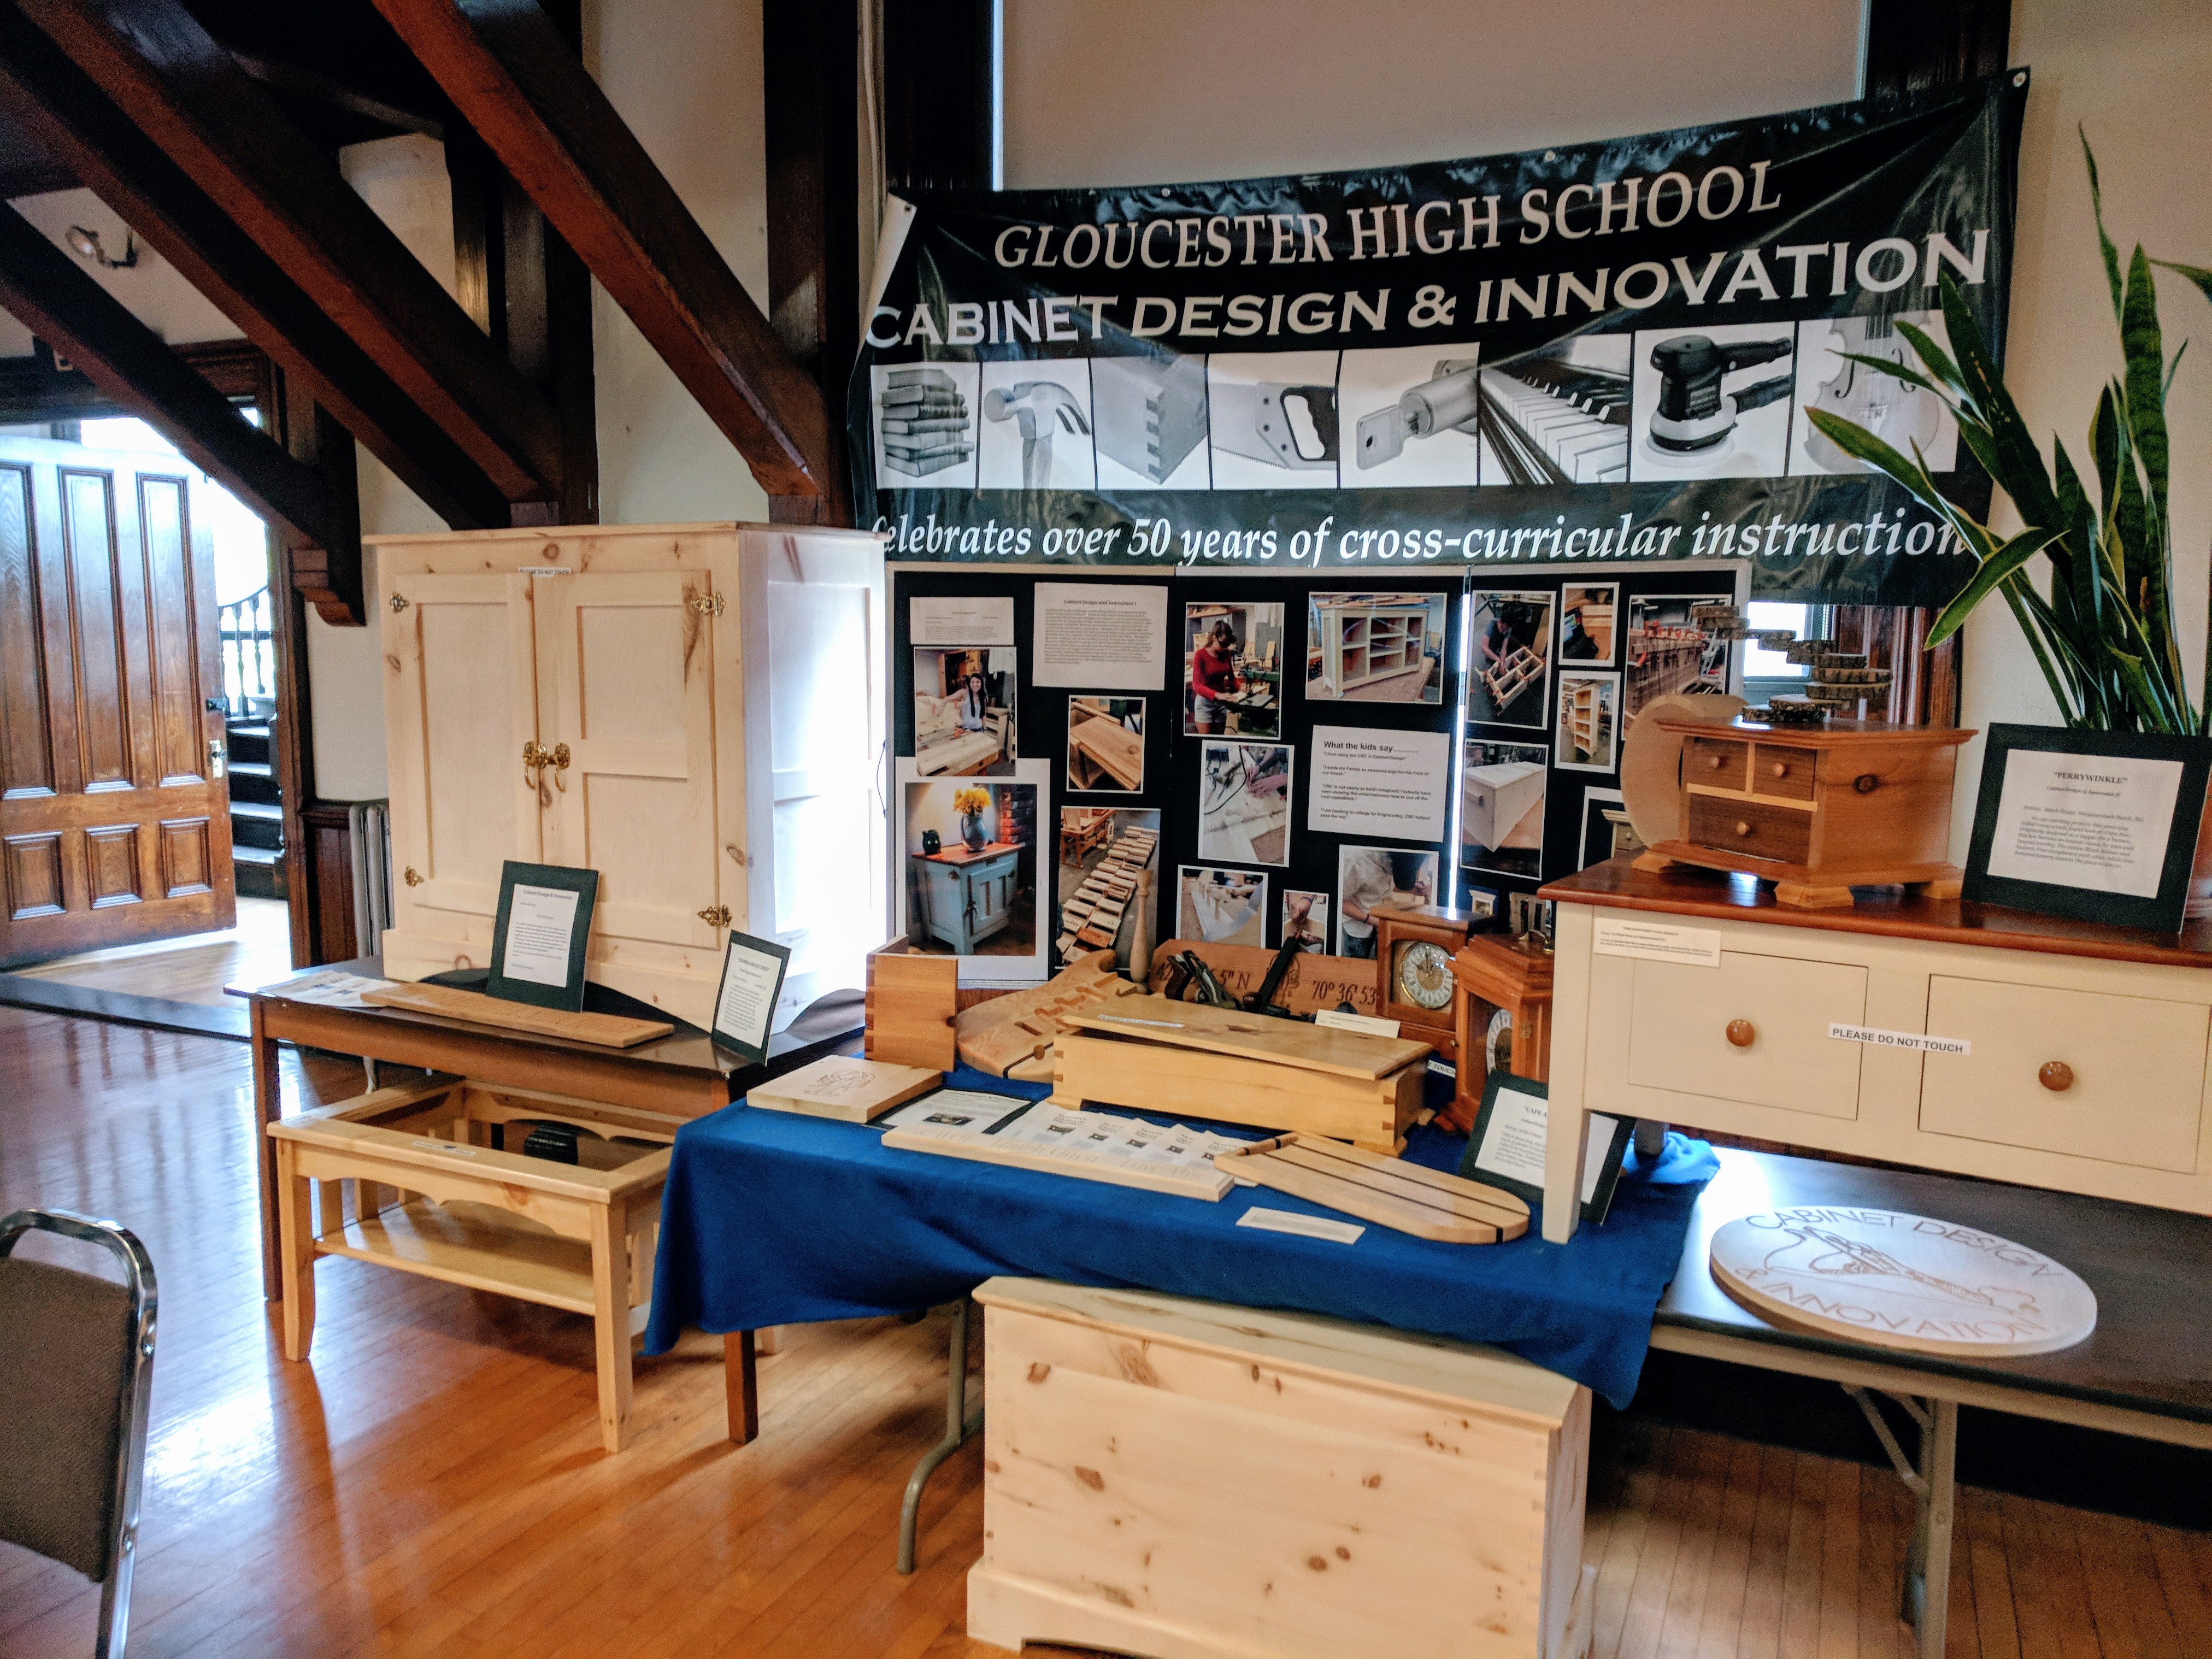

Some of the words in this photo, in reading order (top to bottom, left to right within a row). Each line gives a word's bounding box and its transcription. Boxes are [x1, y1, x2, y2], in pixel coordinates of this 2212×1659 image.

[995, 213, 1334, 269] GLOUCESTER
[1346, 193, 1500, 261] HIGH
[1519, 160, 1781, 245] SCHOOL
[866, 294, 1119, 349] CABINET
[1132, 287, 1392, 337] DESIGN
[1408, 284, 1456, 326] &
[1474, 228, 1991, 325] INNOVATION
[1042, 519, 1120, 556] over
[1128, 518, 1171, 558] 50
[1179, 522, 1289, 568] years
[1291, 516, 1333, 568] of
[1340, 511, 1681, 561] cross-curricular
[1692, 507, 1967, 558] instruction
[1833, 1028, 1875, 1042] PLEASE
[1878, 1034, 1893, 1044] DO
[1897, 1038, 1919, 1048] NOT
[1923, 1041, 1963, 1054] TOUCH
[1745, 1209, 1905, 1230] CABINET
[1913, 1220, 2064, 1278] DESIGN
[1762, 1282, 2051, 1343] INNOVATION
